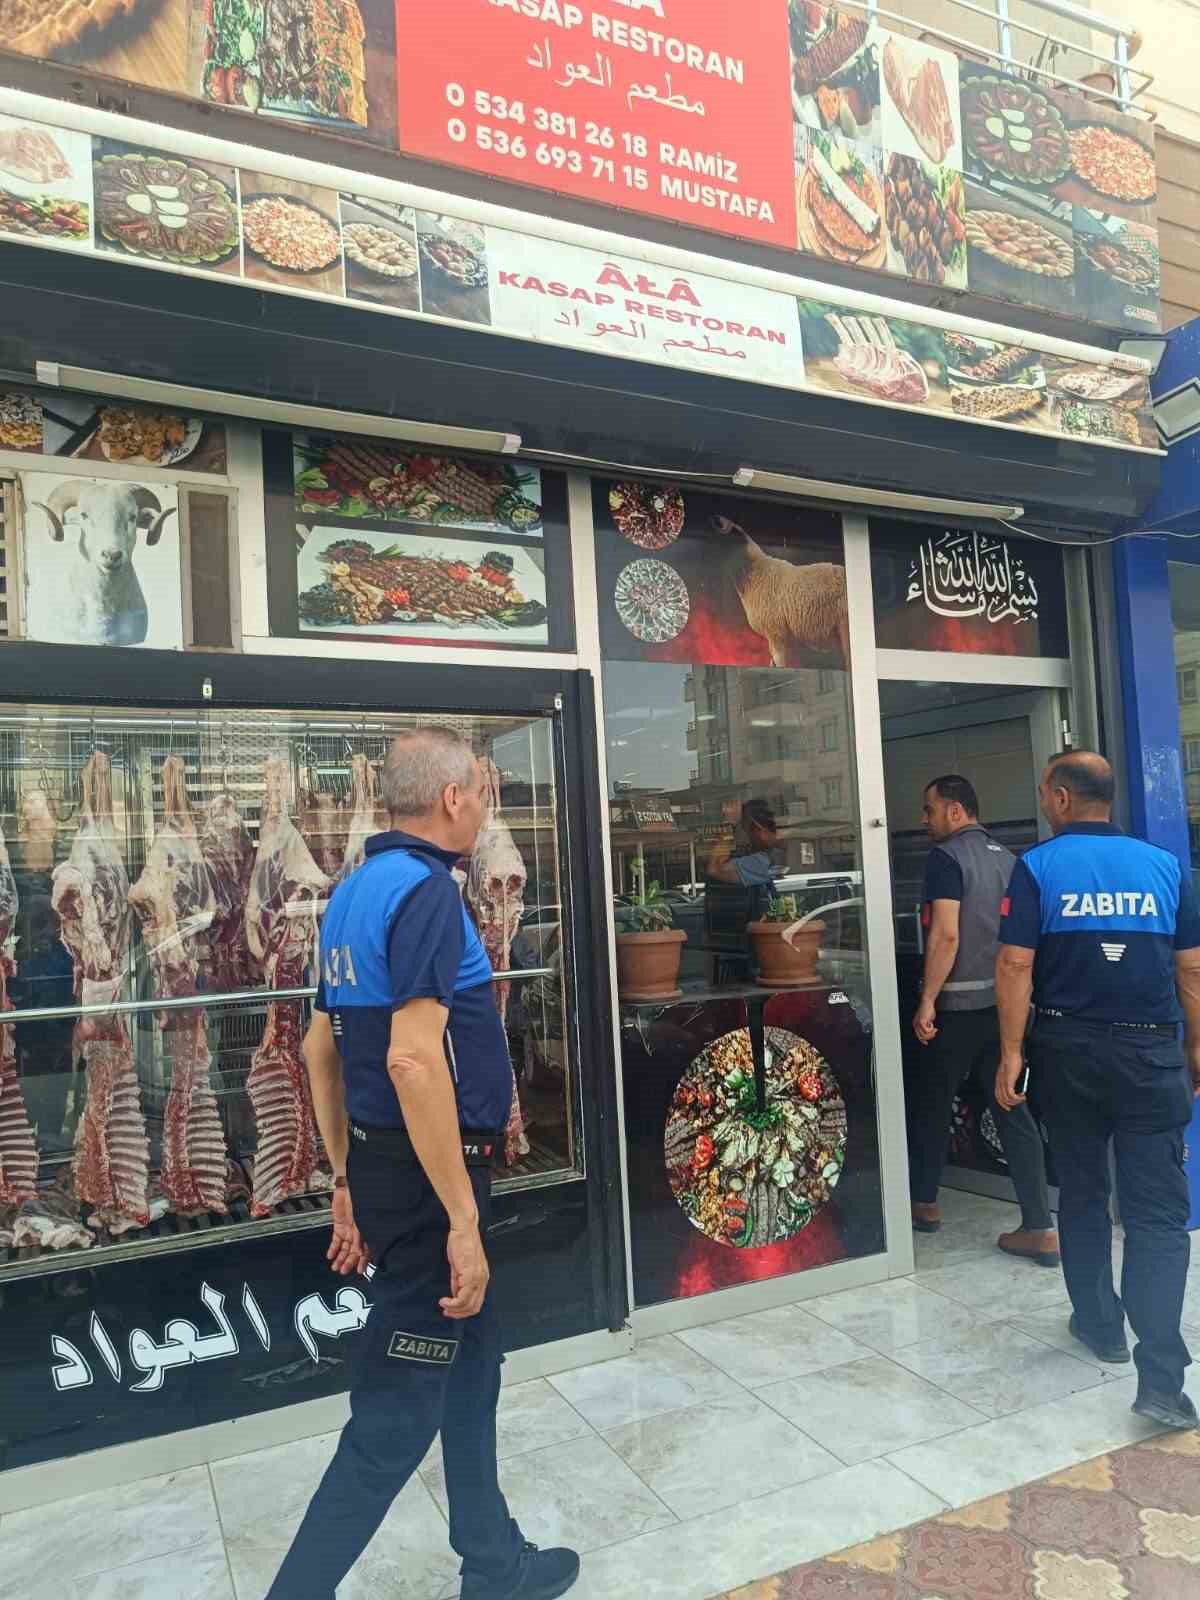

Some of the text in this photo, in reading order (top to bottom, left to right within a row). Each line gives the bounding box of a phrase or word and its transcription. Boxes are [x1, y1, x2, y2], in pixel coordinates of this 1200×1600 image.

[591, 12, 745, 84] RESTORAN
[626, 71, 706, 116] مطعم
[474, 88, 526, 125] 534
[533, 106, 577, 139] 381
[585, 121, 615, 149] 26
[621, 131, 648, 158] 18
[659, 142, 739, 183] RAMİZ
[475, 125, 528, 160] 536
[535, 143, 583, 174] 693
[589, 155, 615, 183] 71
[622, 164, 649, 191] 15
[660, 174, 775, 224] MUSTAFA
[498, 269, 787, 345] KASAP RESTORAN
[662, 334, 747, 360] مطعم
[1060, 891, 1159, 918] ZABITA
[395, 1338, 450, 1360] ZABITA
